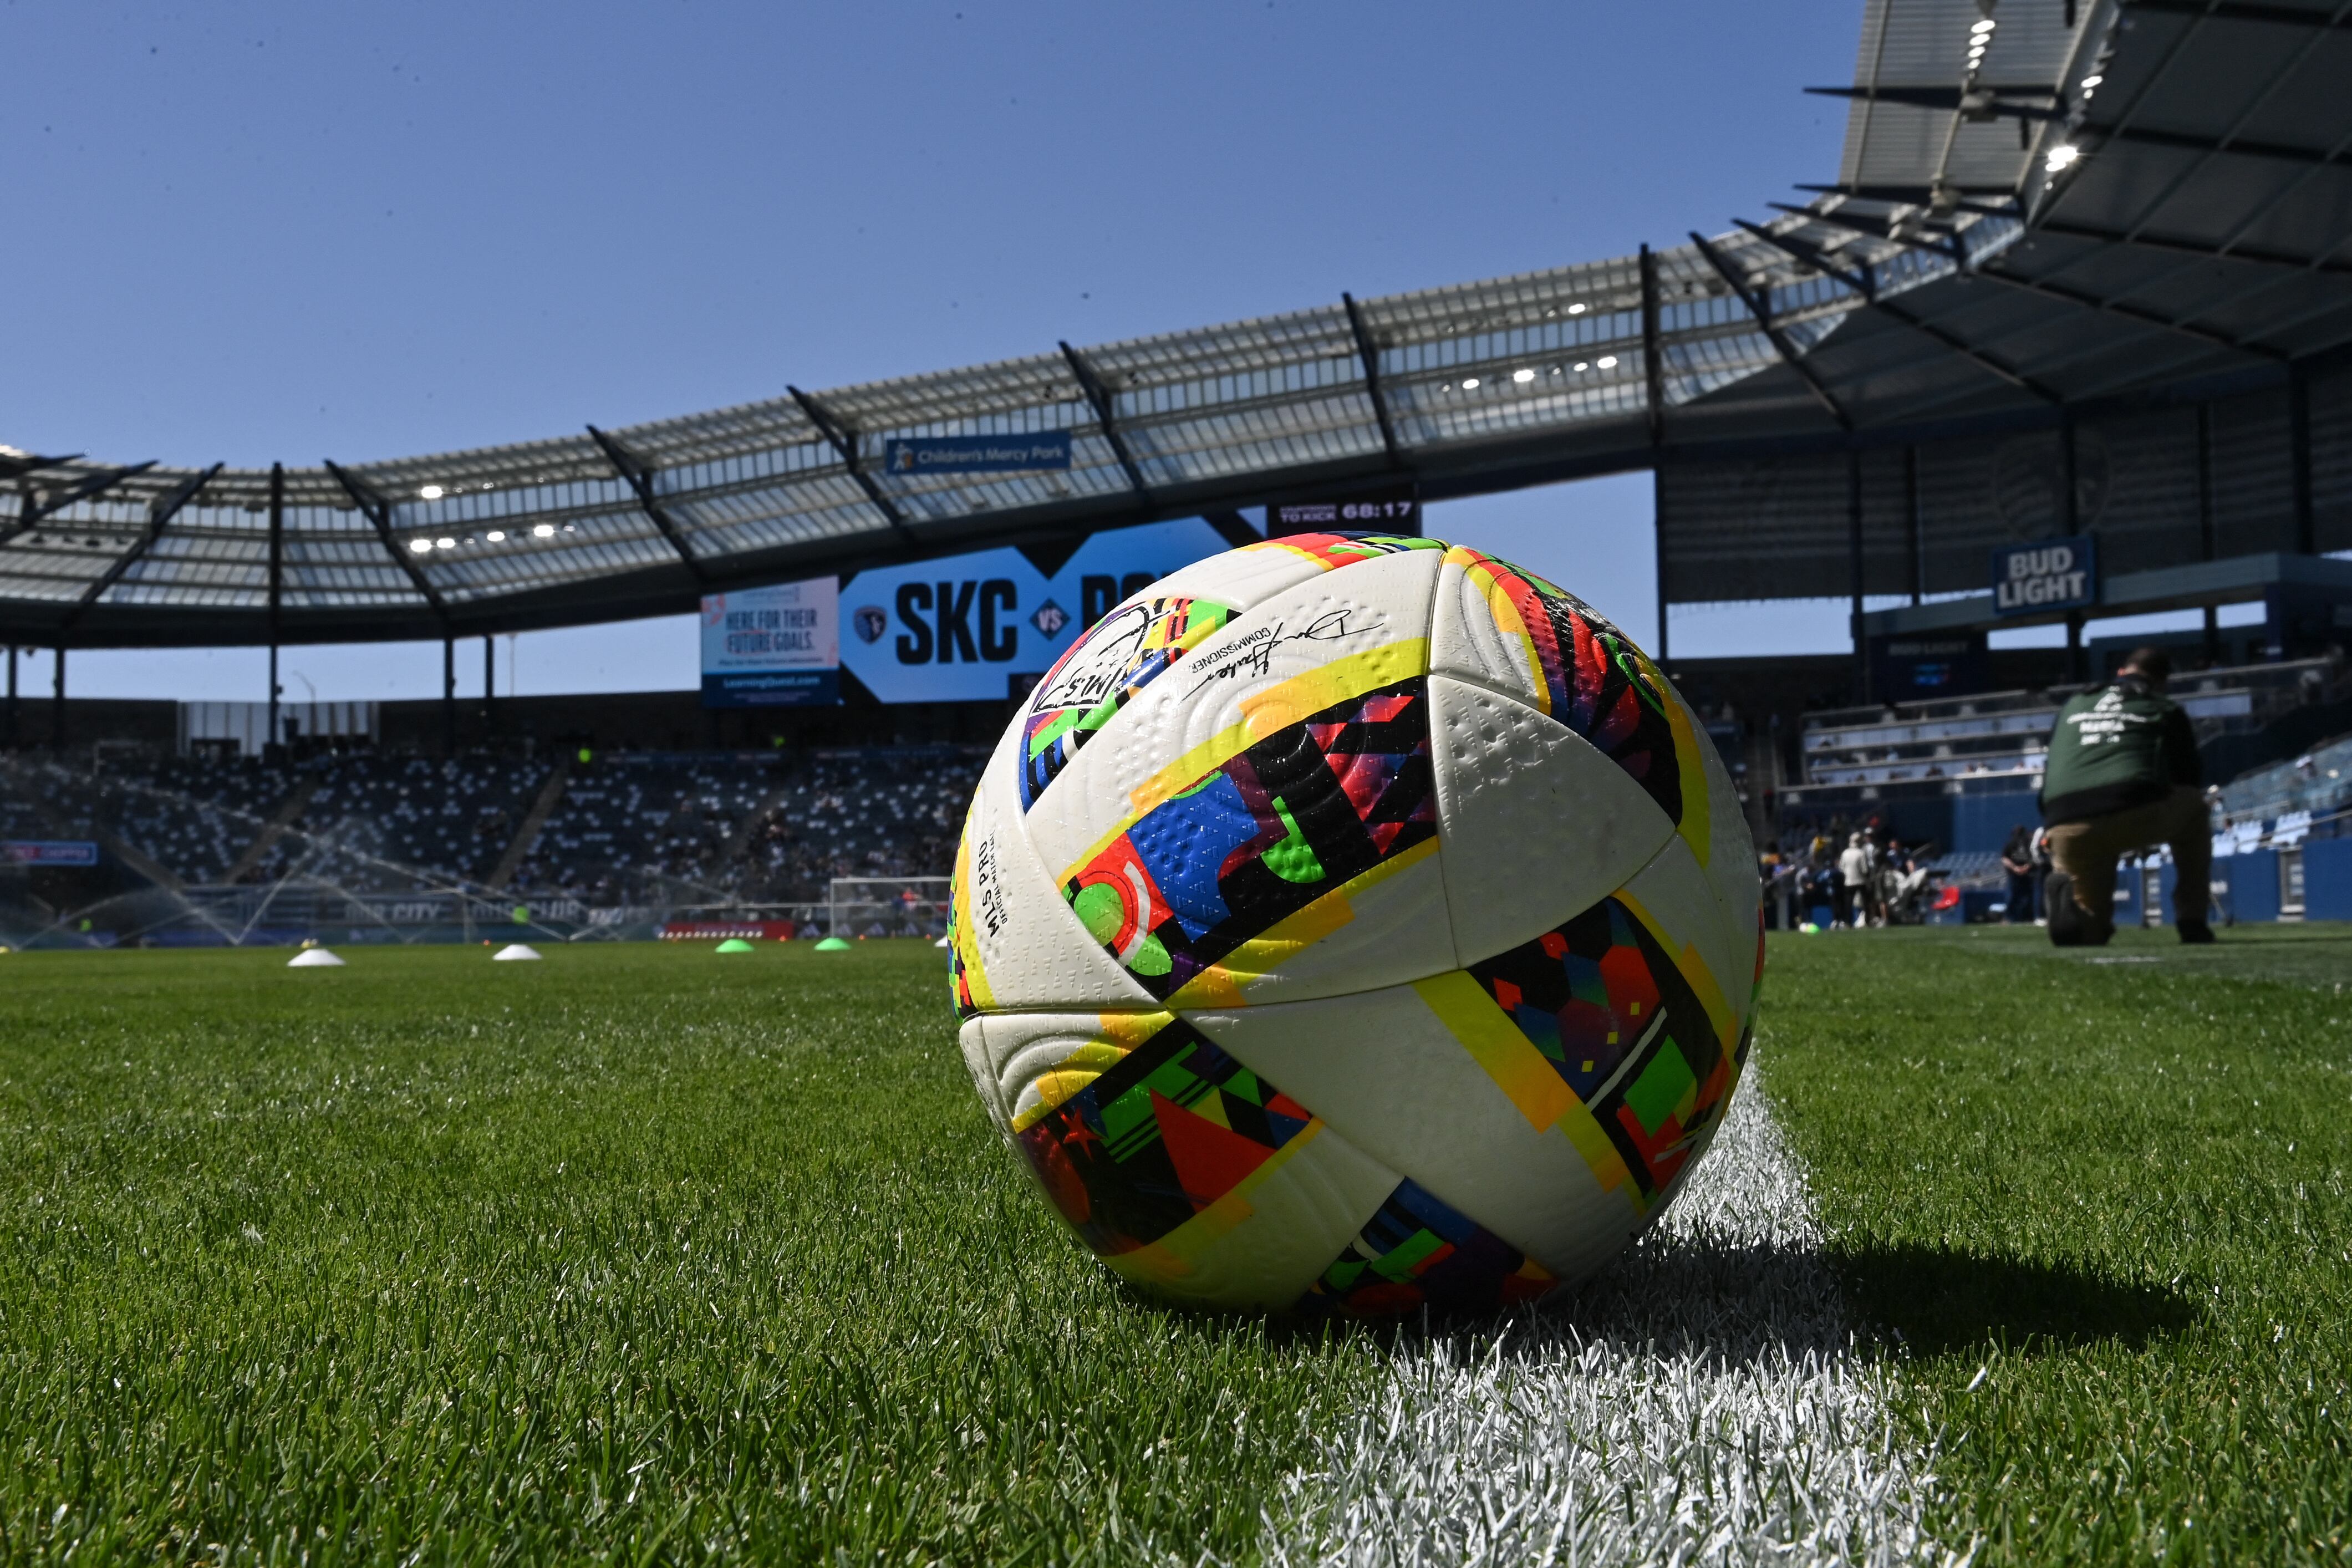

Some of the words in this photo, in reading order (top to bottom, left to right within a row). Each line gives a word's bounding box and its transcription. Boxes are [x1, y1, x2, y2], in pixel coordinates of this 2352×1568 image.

[985, 447, 1029, 464] Mercy
[1031, 445, 1063, 460] Park
[2008, 546, 2074, 579] BUD
[1997, 571, 2086, 608] LIGHT
[895, 579, 1017, 665] SKC
[1038, 607, 1063, 631] VS
[1189, 627, 1272, 674] COMMISSIONER
[1064, 673, 1112, 699] MLS
[979, 841, 989, 887] PRO
[392, 903, 441, 922] CITY
[982, 889, 1000, 938] MLS
[994, 883, 1008, 925] OFFICIAL
